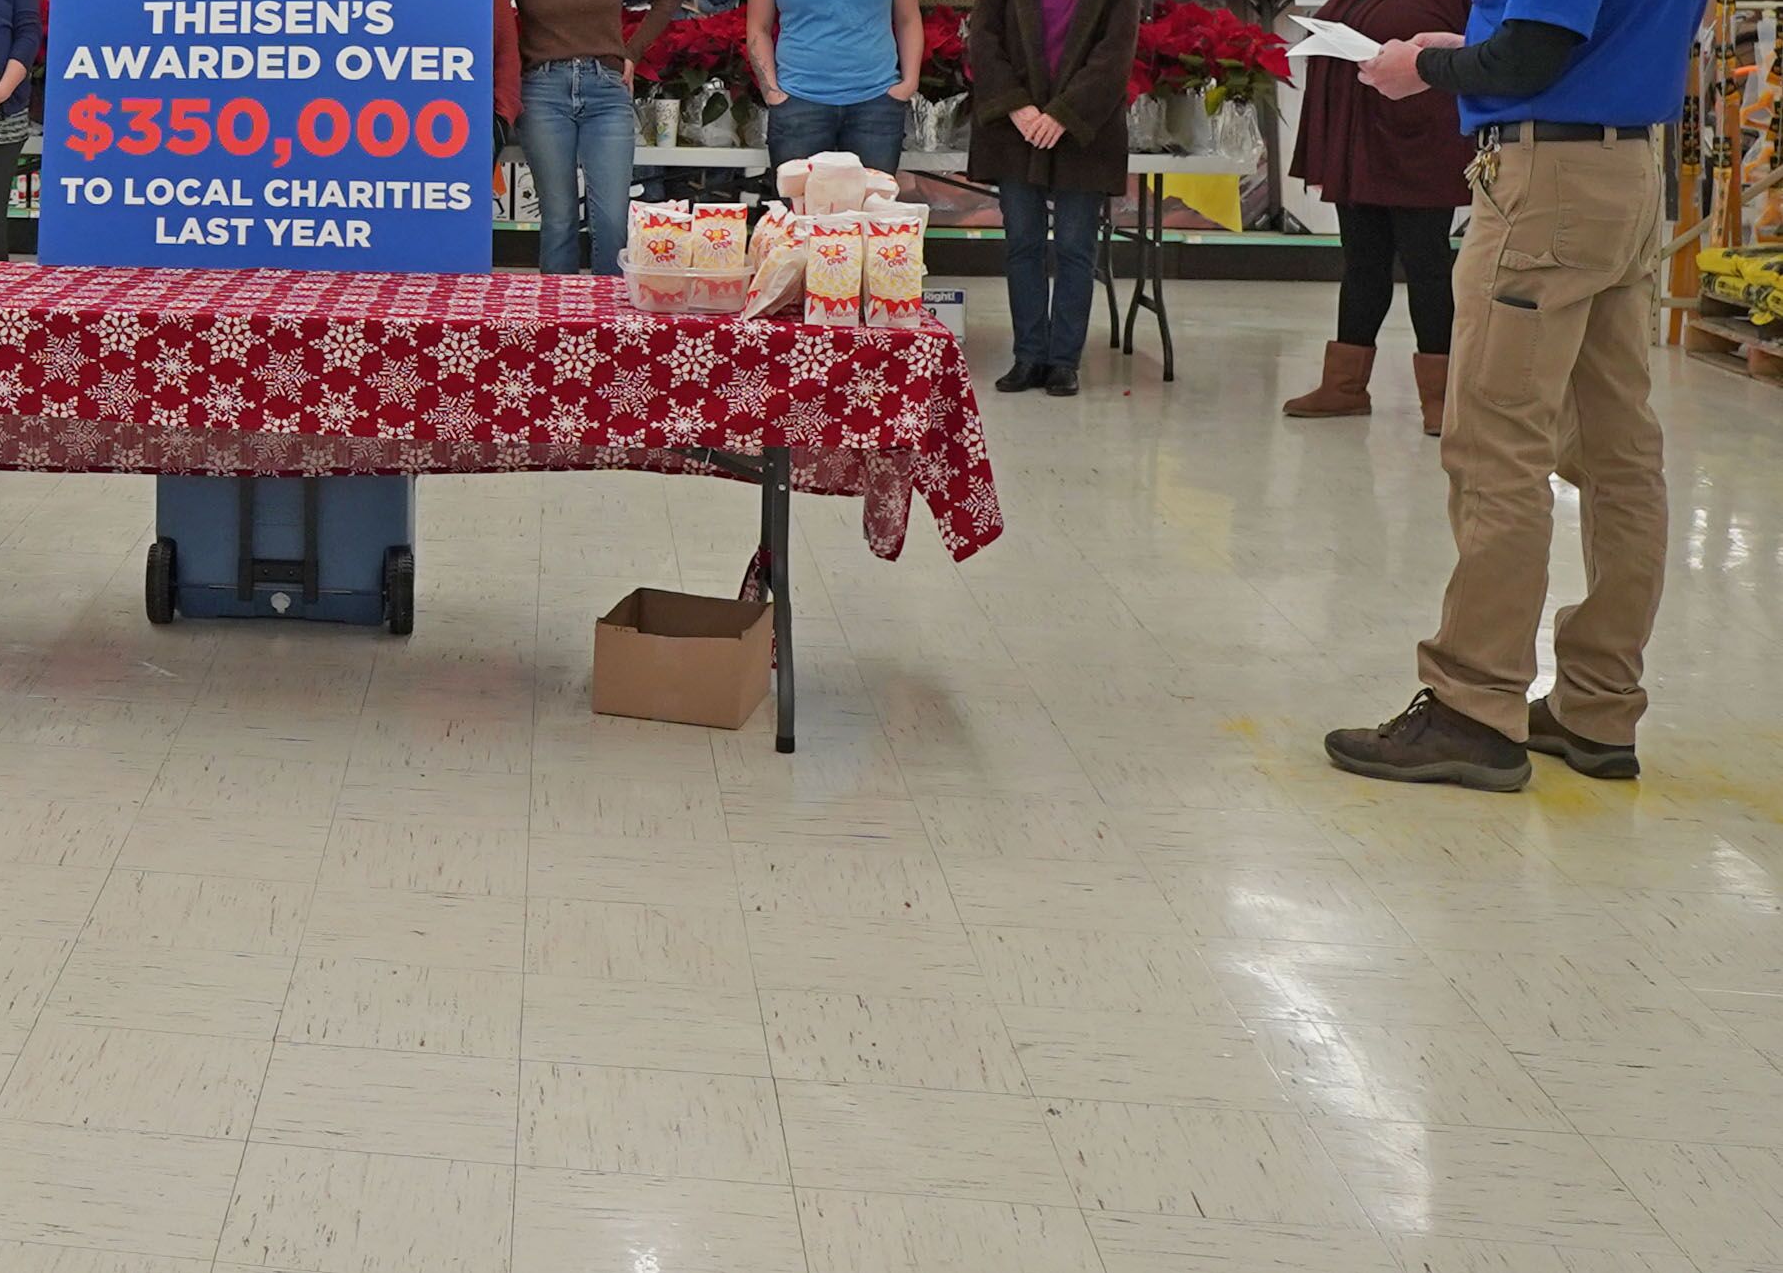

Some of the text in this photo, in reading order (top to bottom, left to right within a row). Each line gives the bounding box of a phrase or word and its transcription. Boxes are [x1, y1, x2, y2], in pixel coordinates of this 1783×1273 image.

[63, 46, 475, 81] AWARDED OVER
[64, 93, 470, 168] $350,000
[60, 177, 472, 211] TO LOCAL CHARITIES
[155, 217, 372, 248] LAST YEAR
